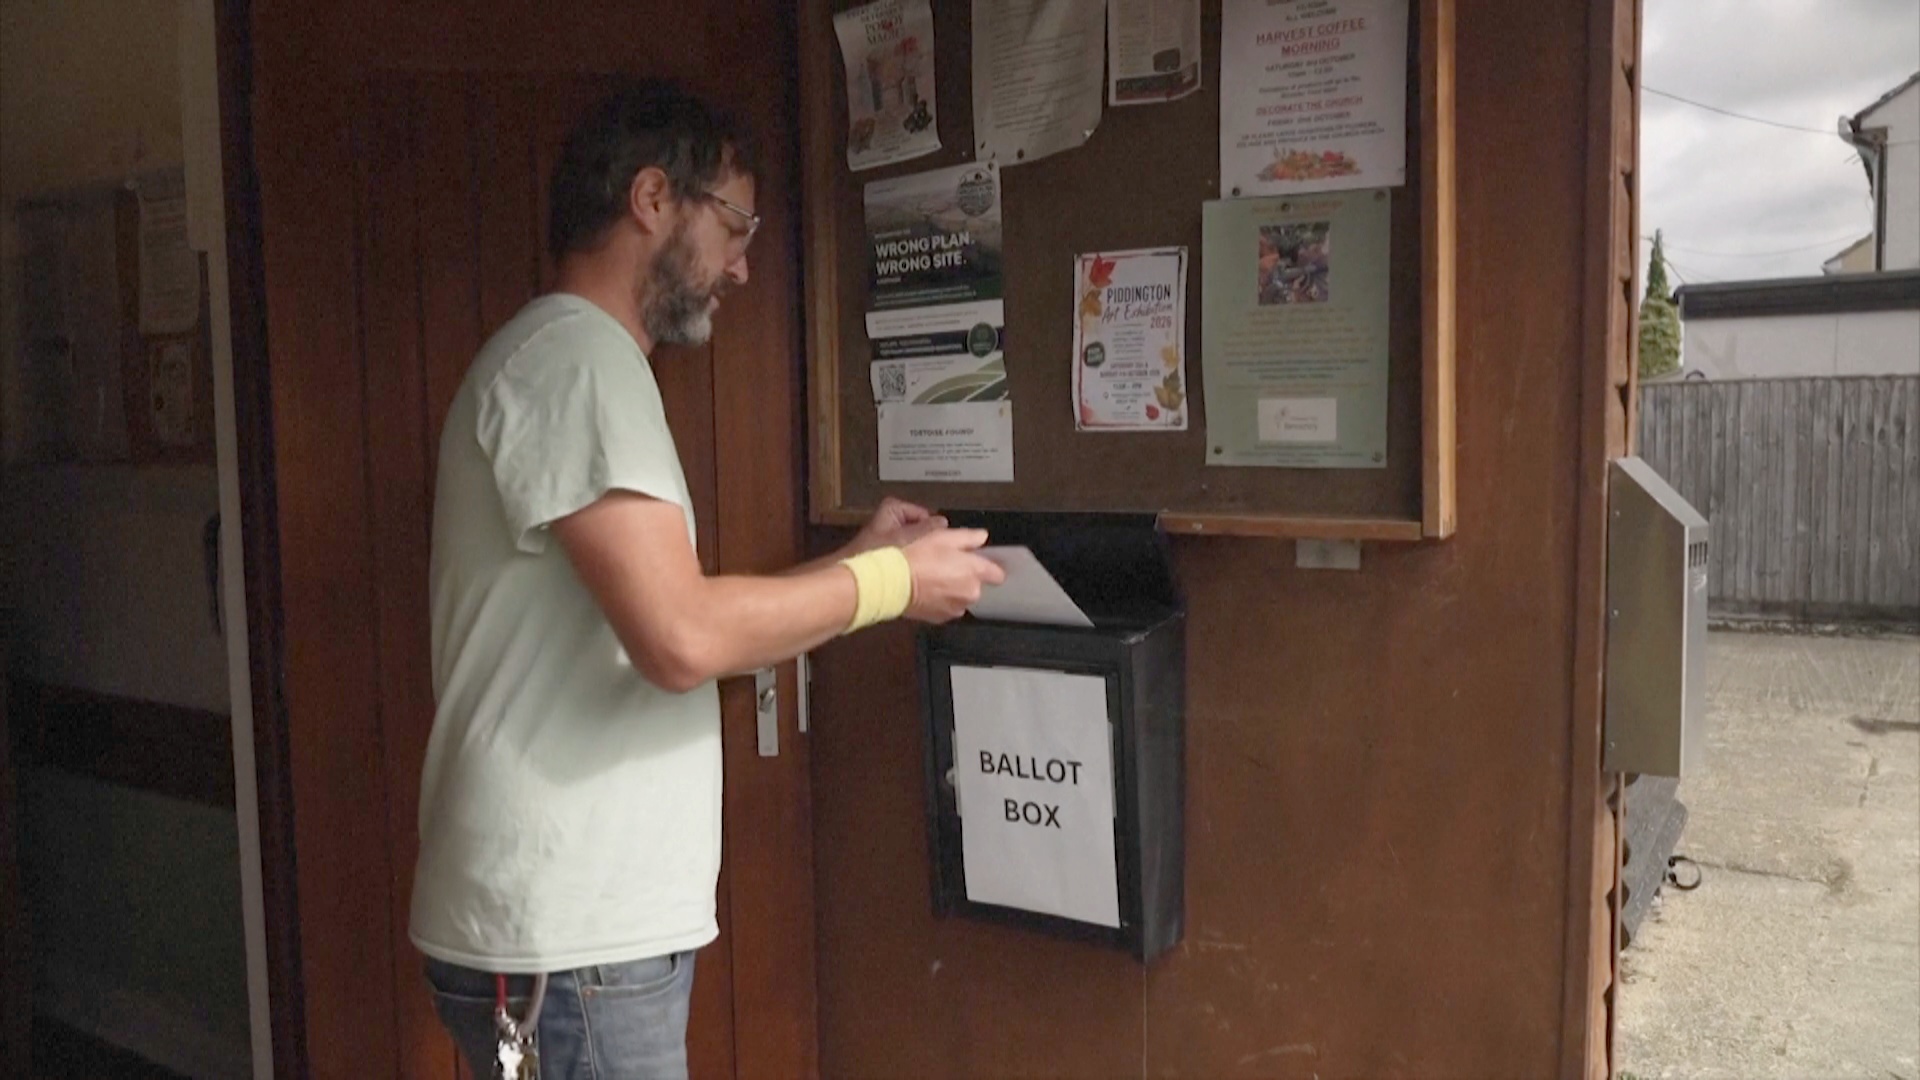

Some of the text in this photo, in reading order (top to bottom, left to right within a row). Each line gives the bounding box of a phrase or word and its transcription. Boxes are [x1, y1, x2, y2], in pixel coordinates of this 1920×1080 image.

[1256, 18, 1365, 44] HARVEST COFFEE
[1281, 38, 1340, 55] MORNING
[1256, 96, 1363, 116] DECORATE THE CHURCH
[875, 238, 930, 258] WRONG
[932, 231, 975, 249] PLAN.
[876, 251, 967, 276] WRONG SITE.
[1107, 284, 1171, 303] PIDDINGTON
[1102, 305, 1119, 324] Art
[979, 750, 1082, 786] BALLOT
[1004, 798, 1062, 830] BOX
